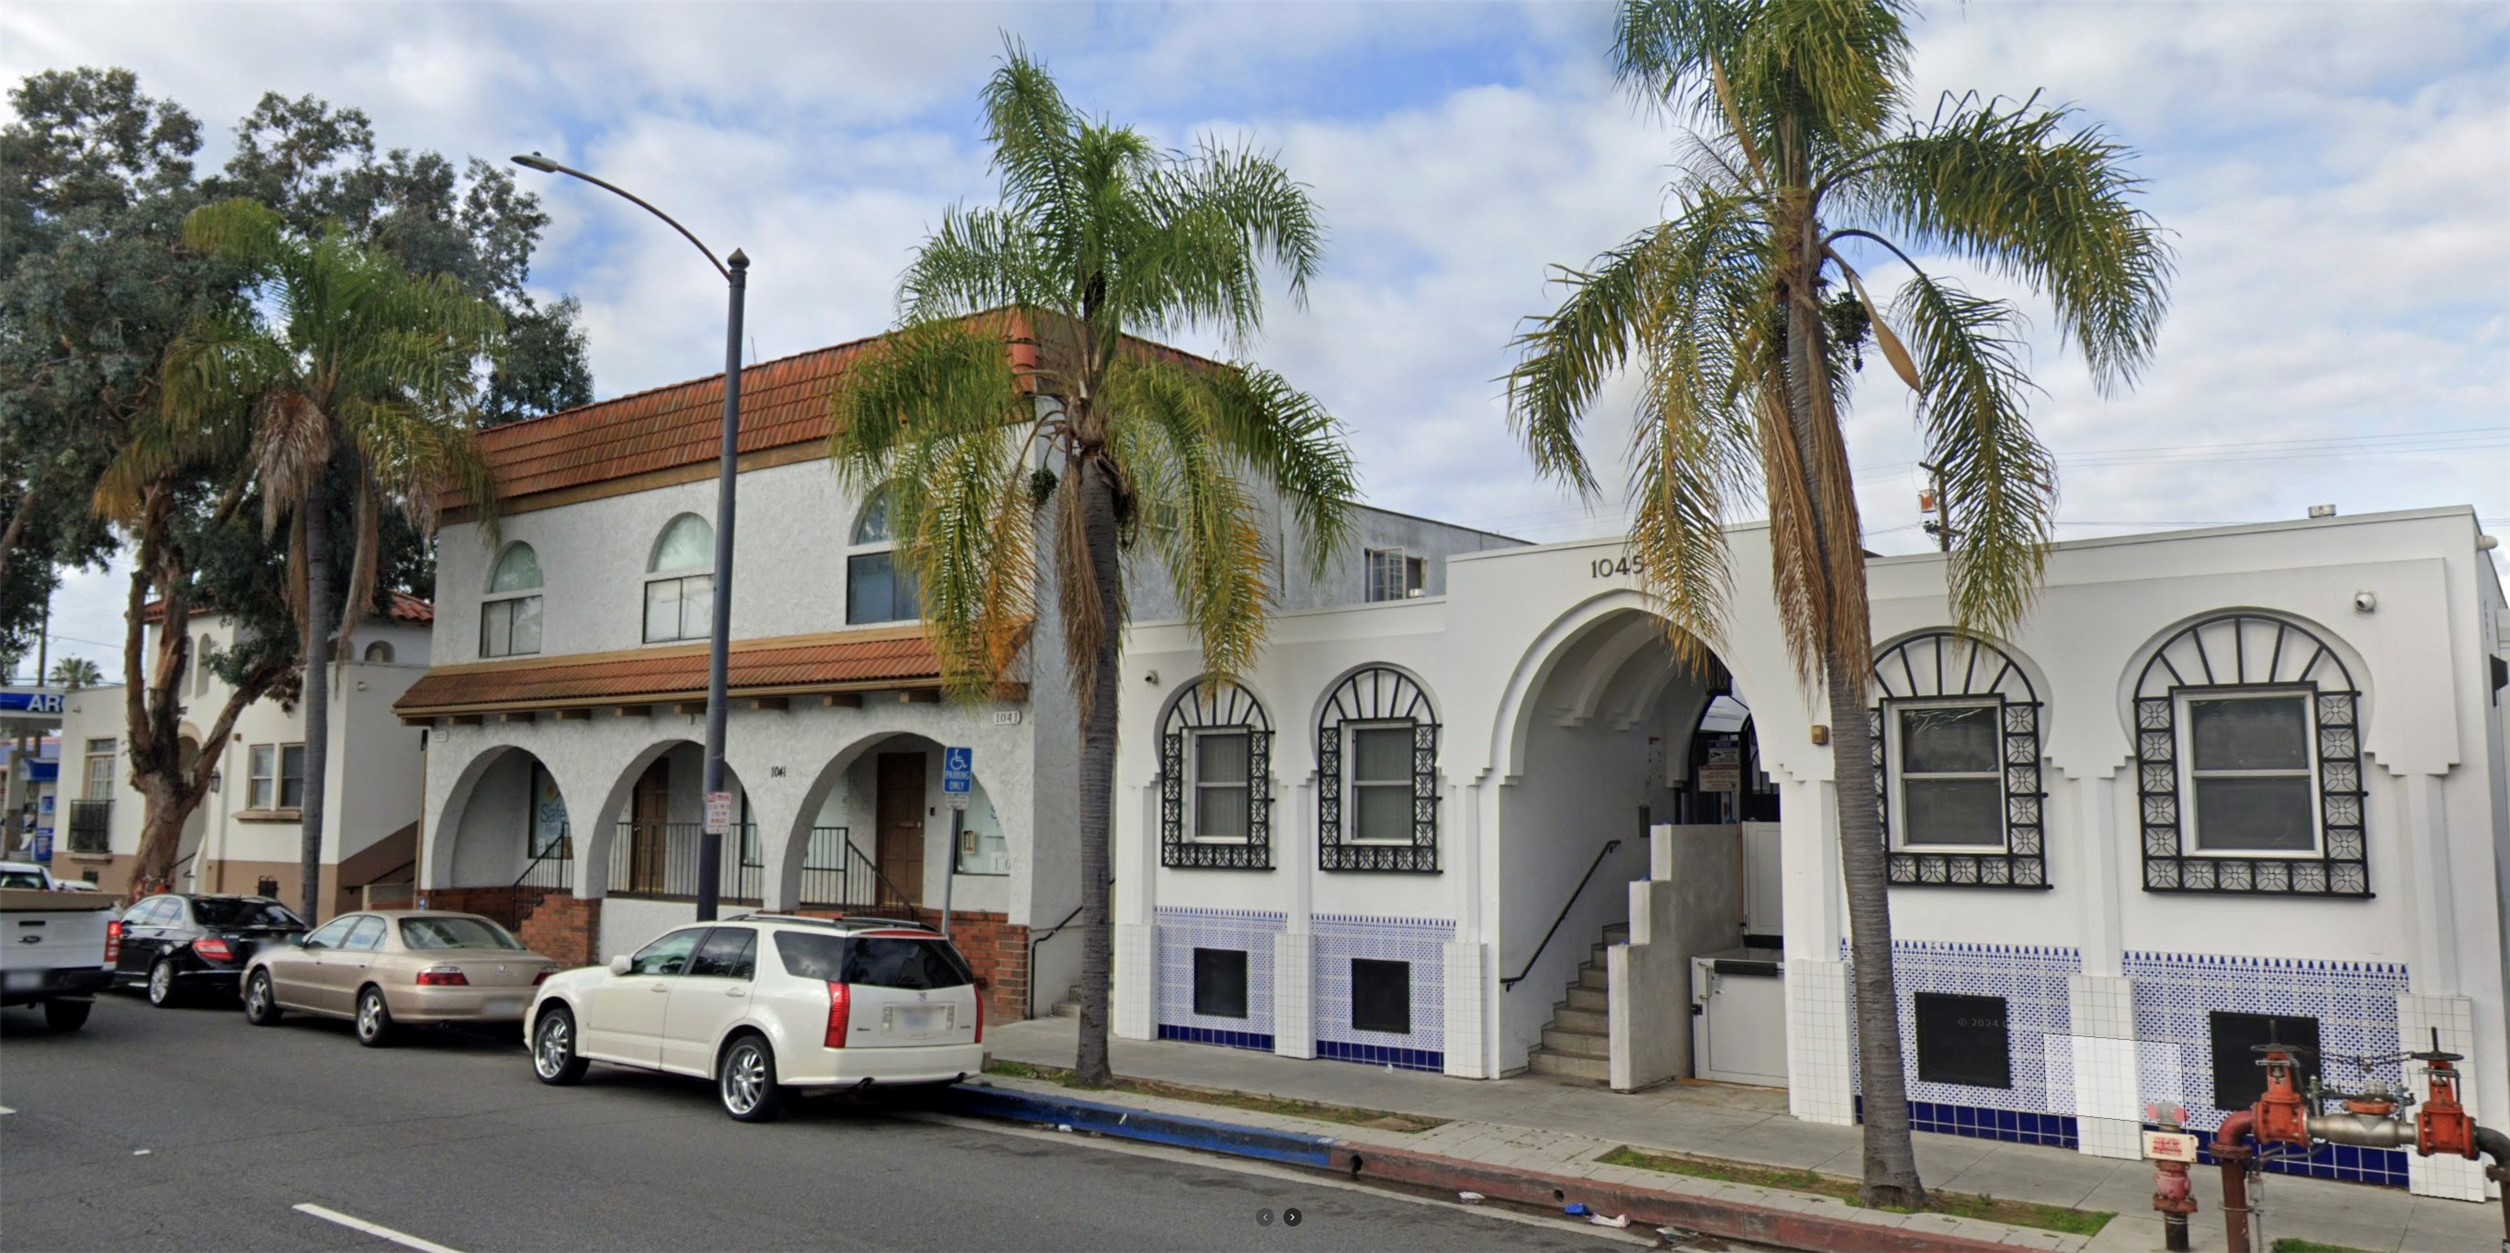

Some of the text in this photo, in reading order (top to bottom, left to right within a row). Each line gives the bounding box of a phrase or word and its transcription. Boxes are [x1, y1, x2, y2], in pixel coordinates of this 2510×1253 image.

[1591, 555, 1644, 579] 1045
[27, 694, 65, 712] AR
[995, 712, 1018, 724] 1041
[540, 803, 567, 823] Safe
